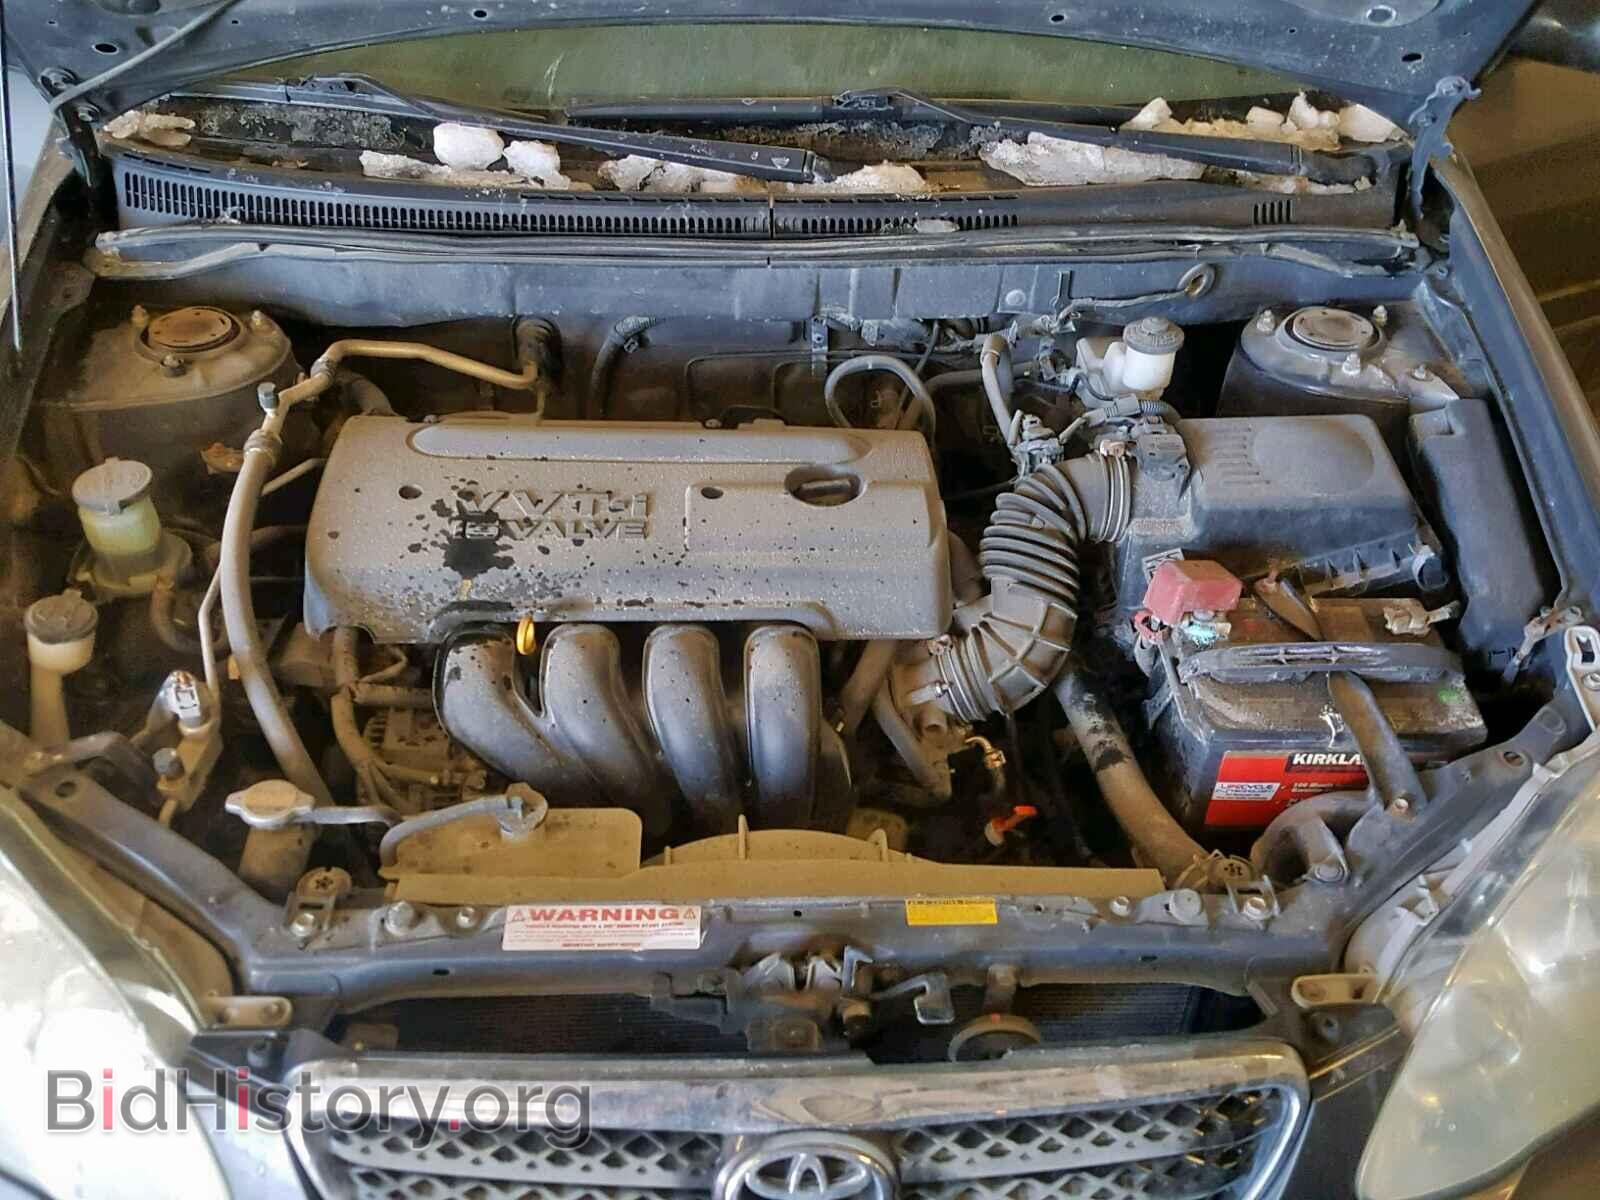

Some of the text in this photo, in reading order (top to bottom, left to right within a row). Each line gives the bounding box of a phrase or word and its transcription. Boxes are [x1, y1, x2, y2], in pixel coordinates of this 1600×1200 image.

[505, 520, 648, 540] VALVE
[1292, 753, 1364, 765] KIRKLA
[529, 908, 680, 921] WARNING
